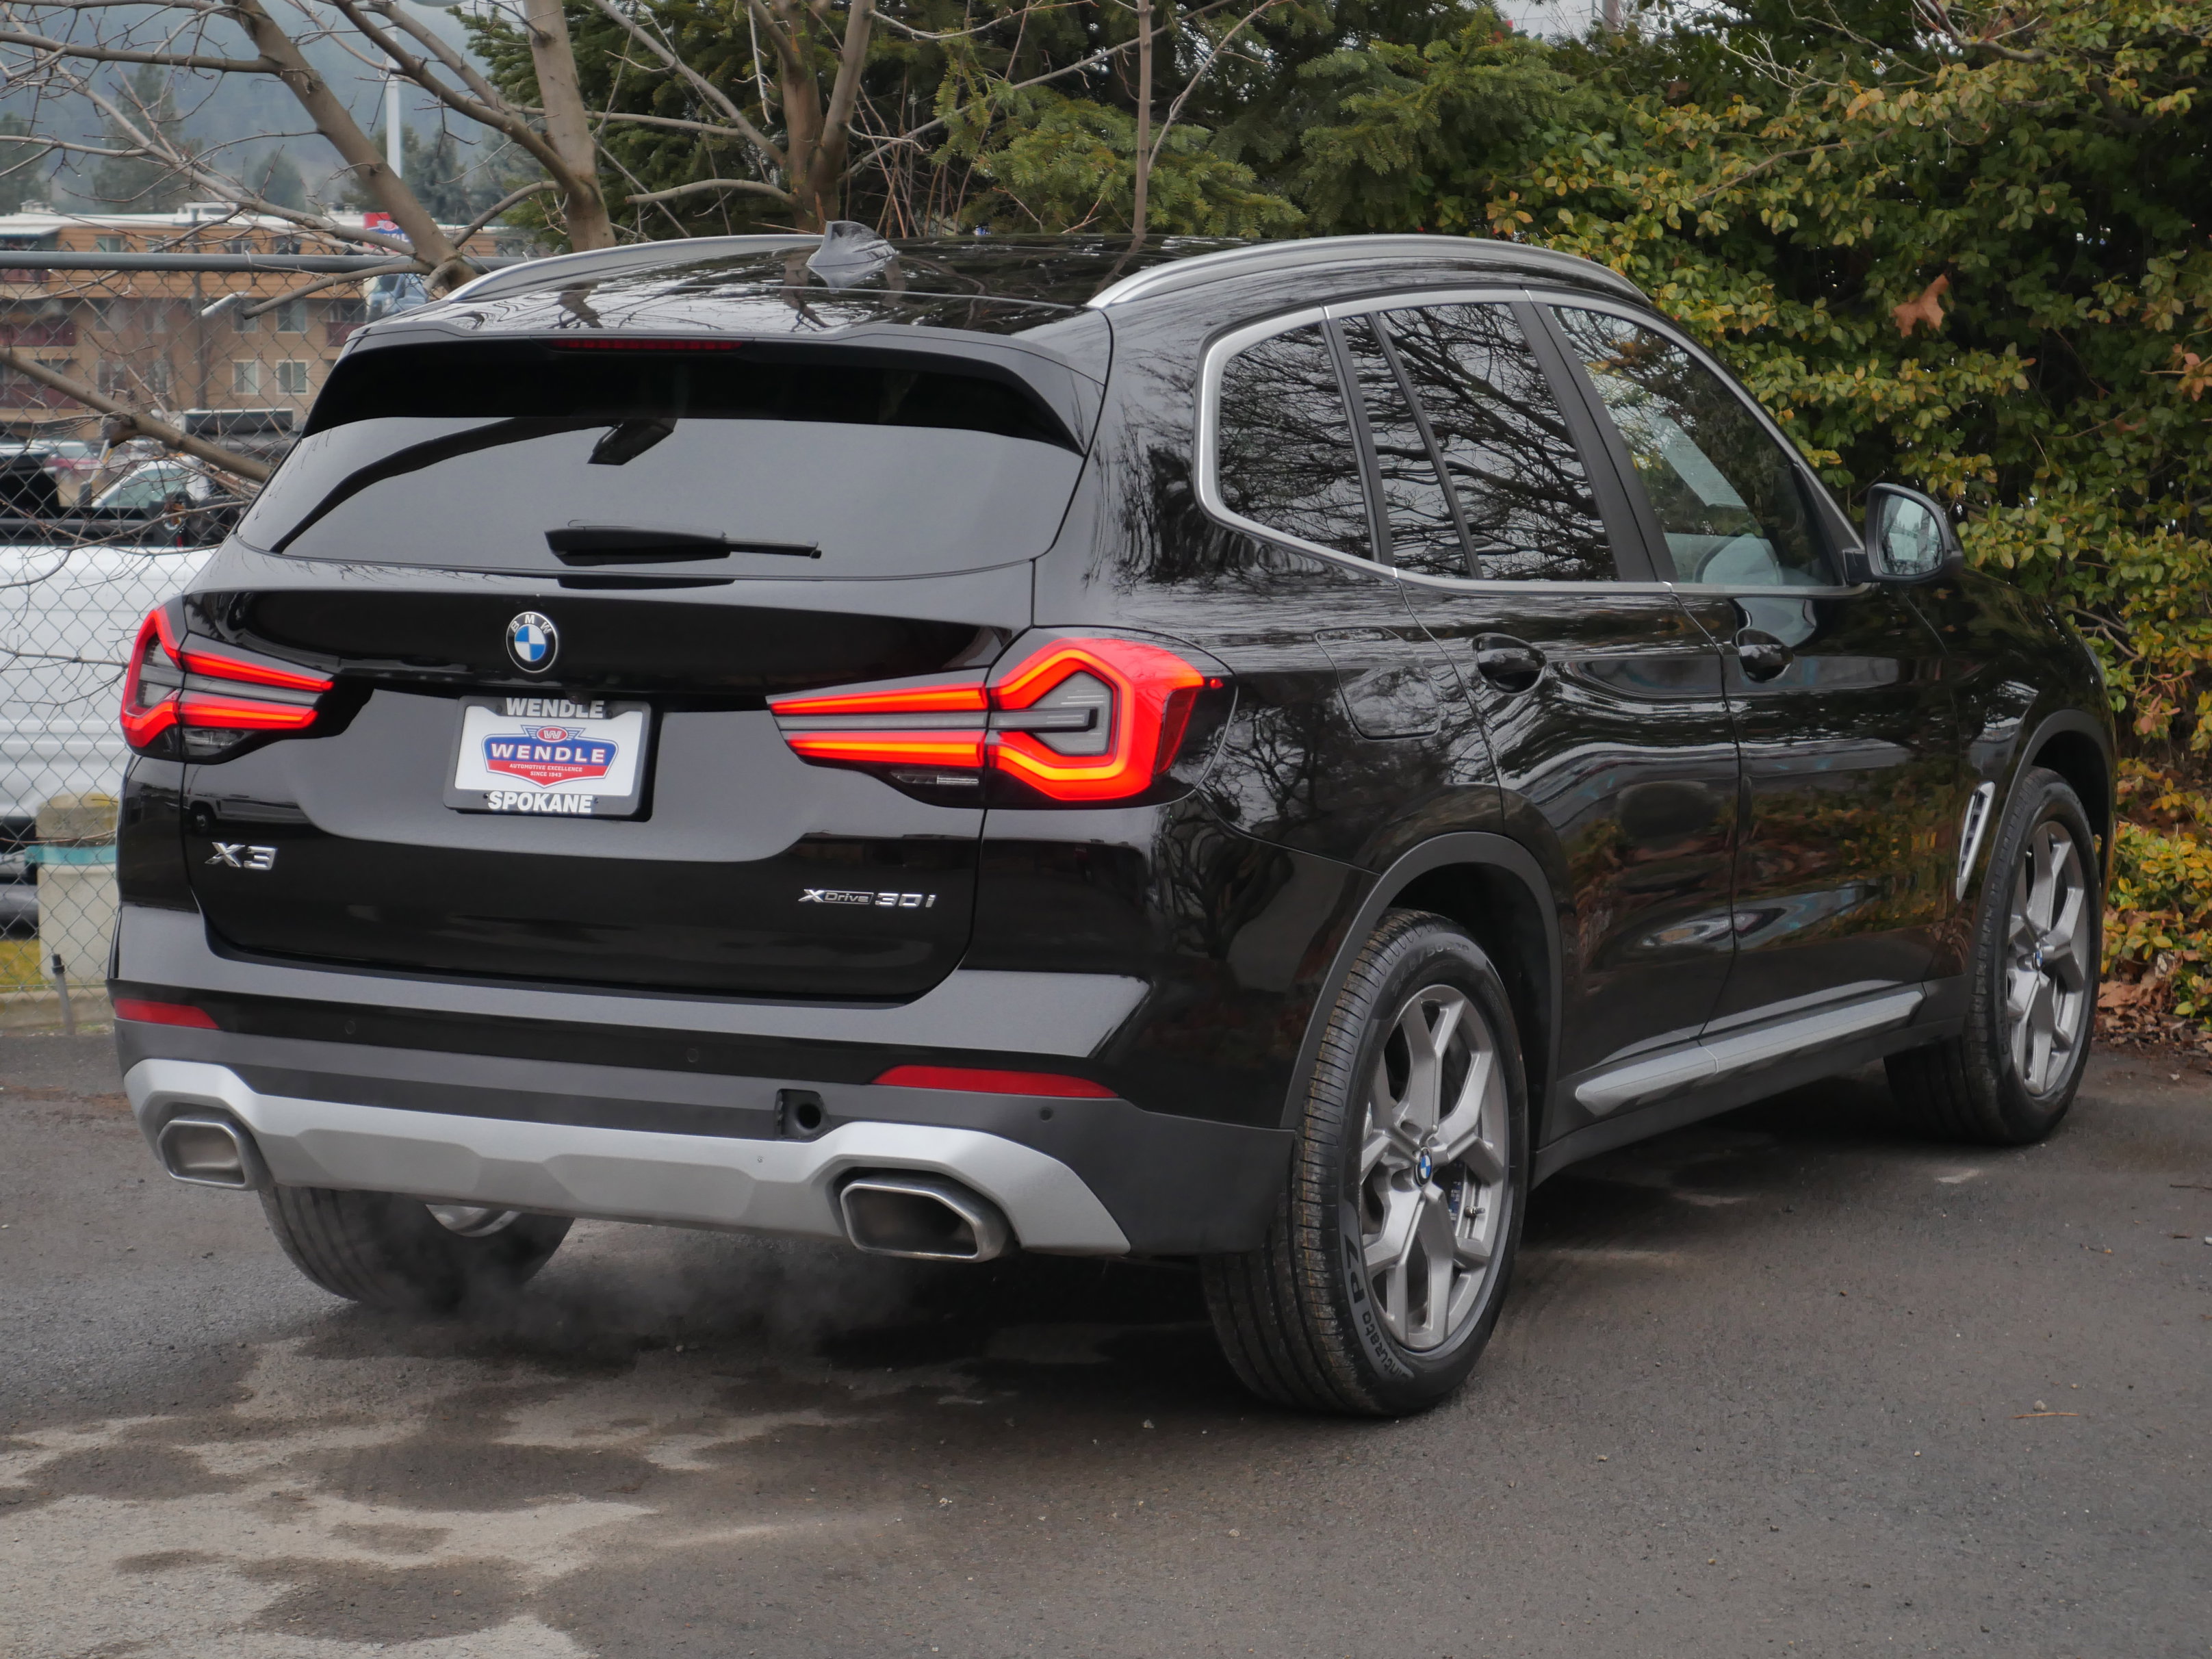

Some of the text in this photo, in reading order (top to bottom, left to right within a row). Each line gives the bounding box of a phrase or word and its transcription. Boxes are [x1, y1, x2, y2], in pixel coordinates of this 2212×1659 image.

[511, 614, 552, 634] BMW
[506, 697, 605, 719] WENDLE
[491, 743, 605, 763] WENDLE
[488, 791, 593, 813] SPOKANE
[205, 842, 277, 870] X3
